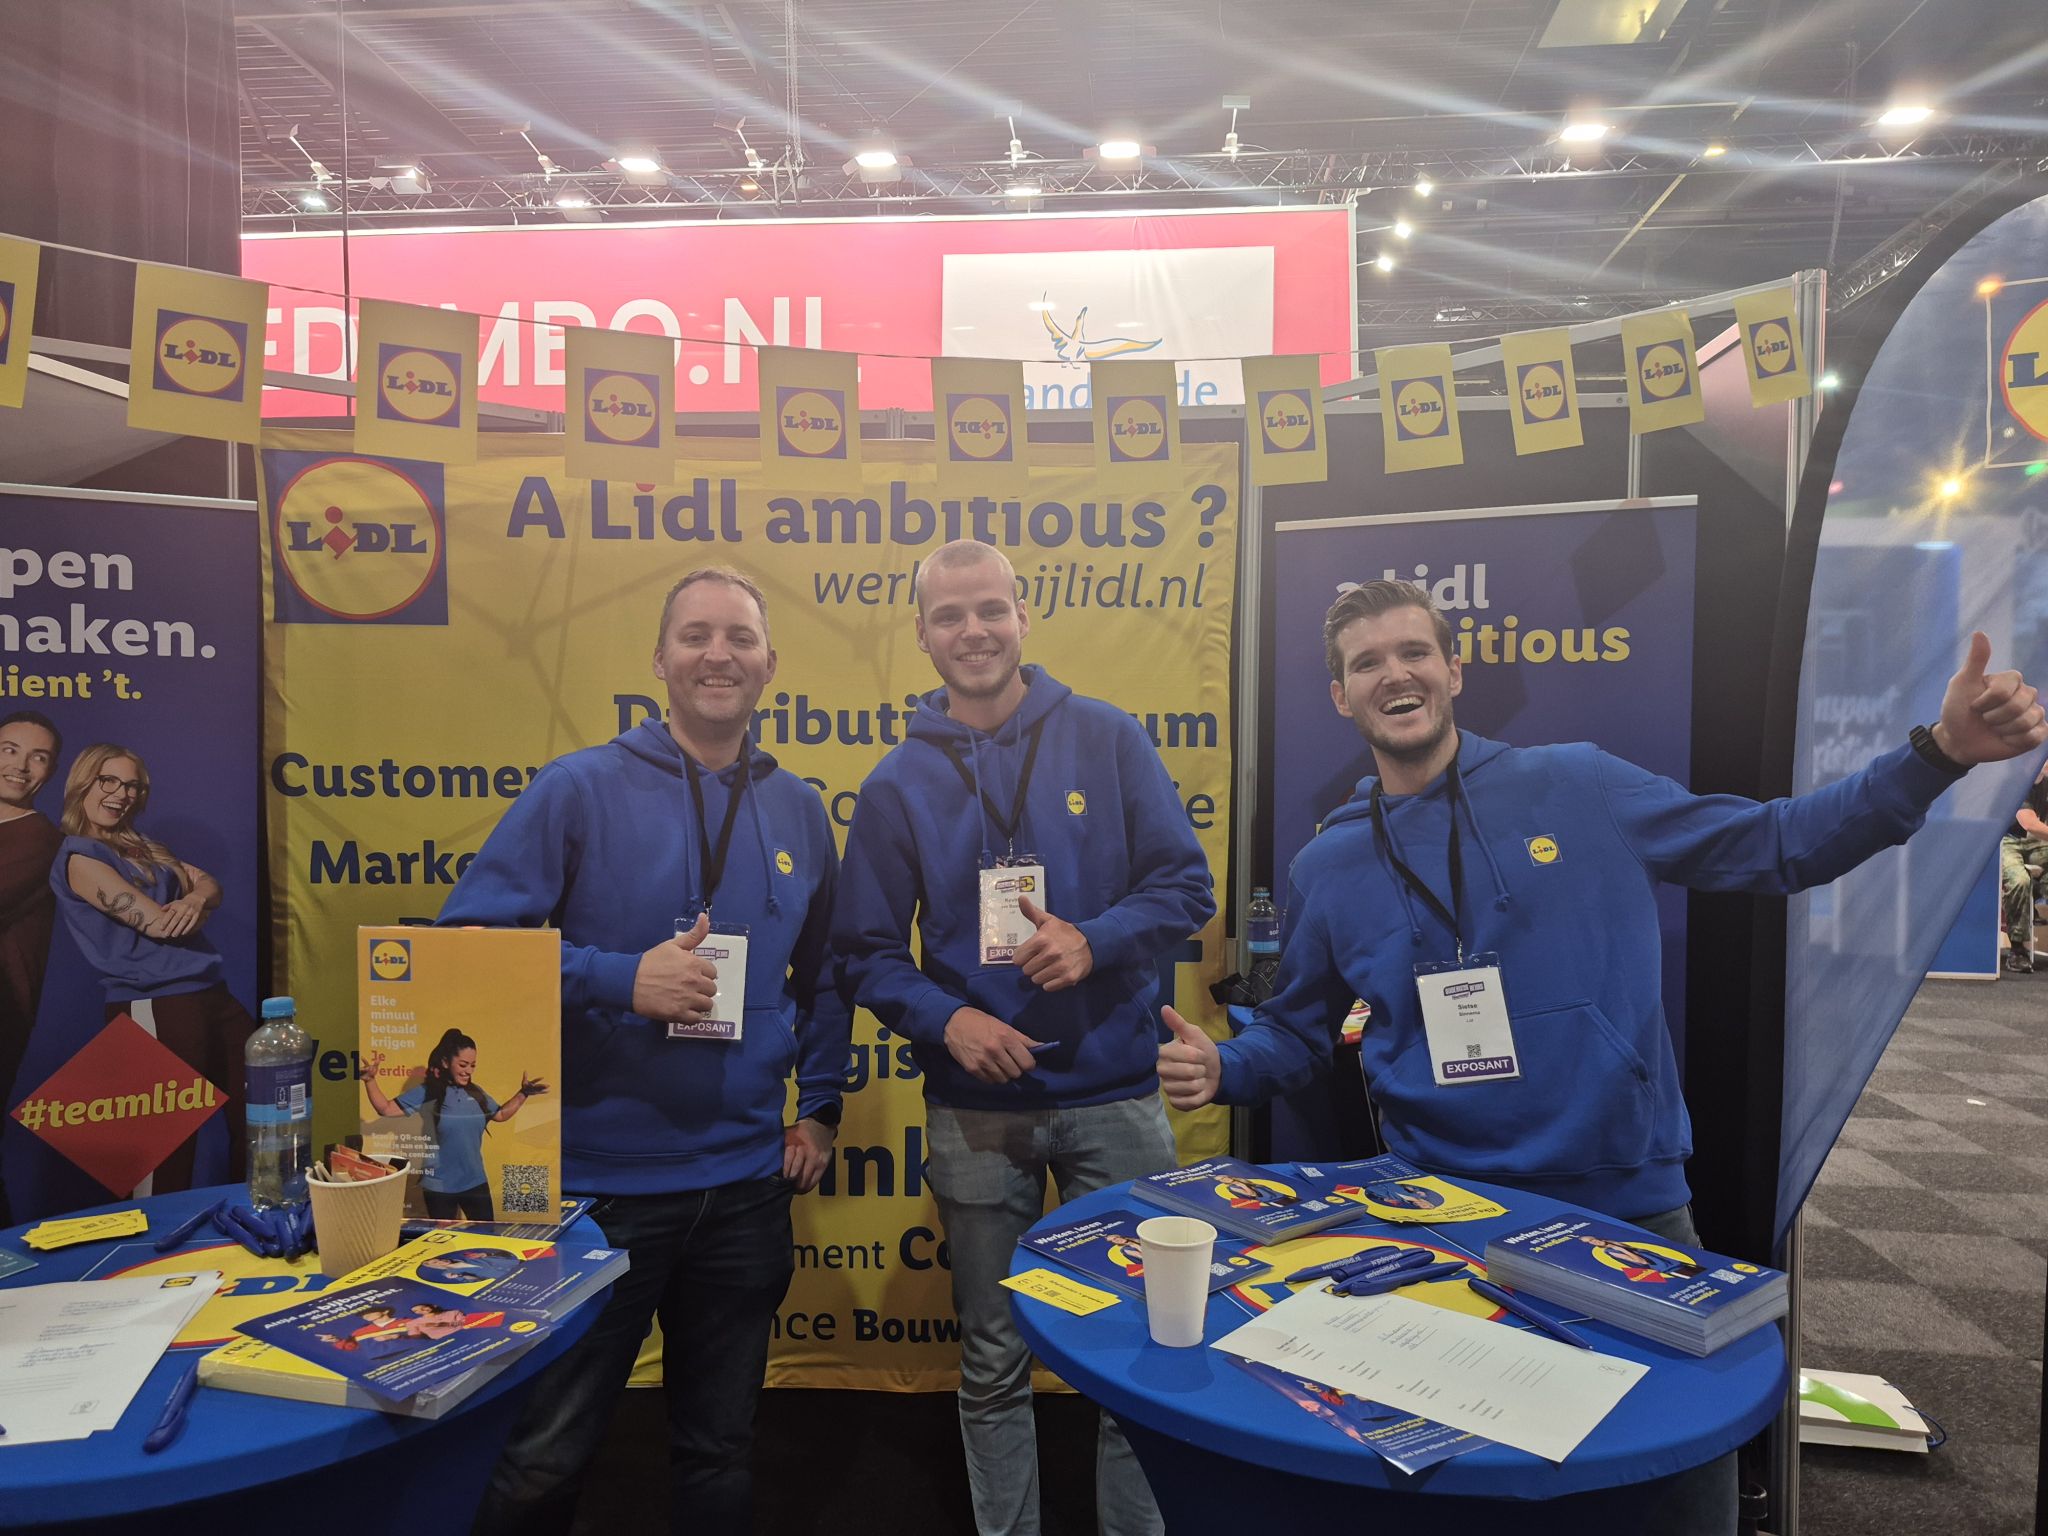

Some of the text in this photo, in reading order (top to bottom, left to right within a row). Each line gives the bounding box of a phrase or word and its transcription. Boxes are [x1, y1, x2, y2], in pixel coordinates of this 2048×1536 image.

[506, 476, 1228, 549] A Lidl ambitious ?
[813, 560, 1205, 620] werijlidl.nl
[1446, 1059, 1510, 1074] EXPOSANT
[20, 1077, 216, 1131] #teamlidl
